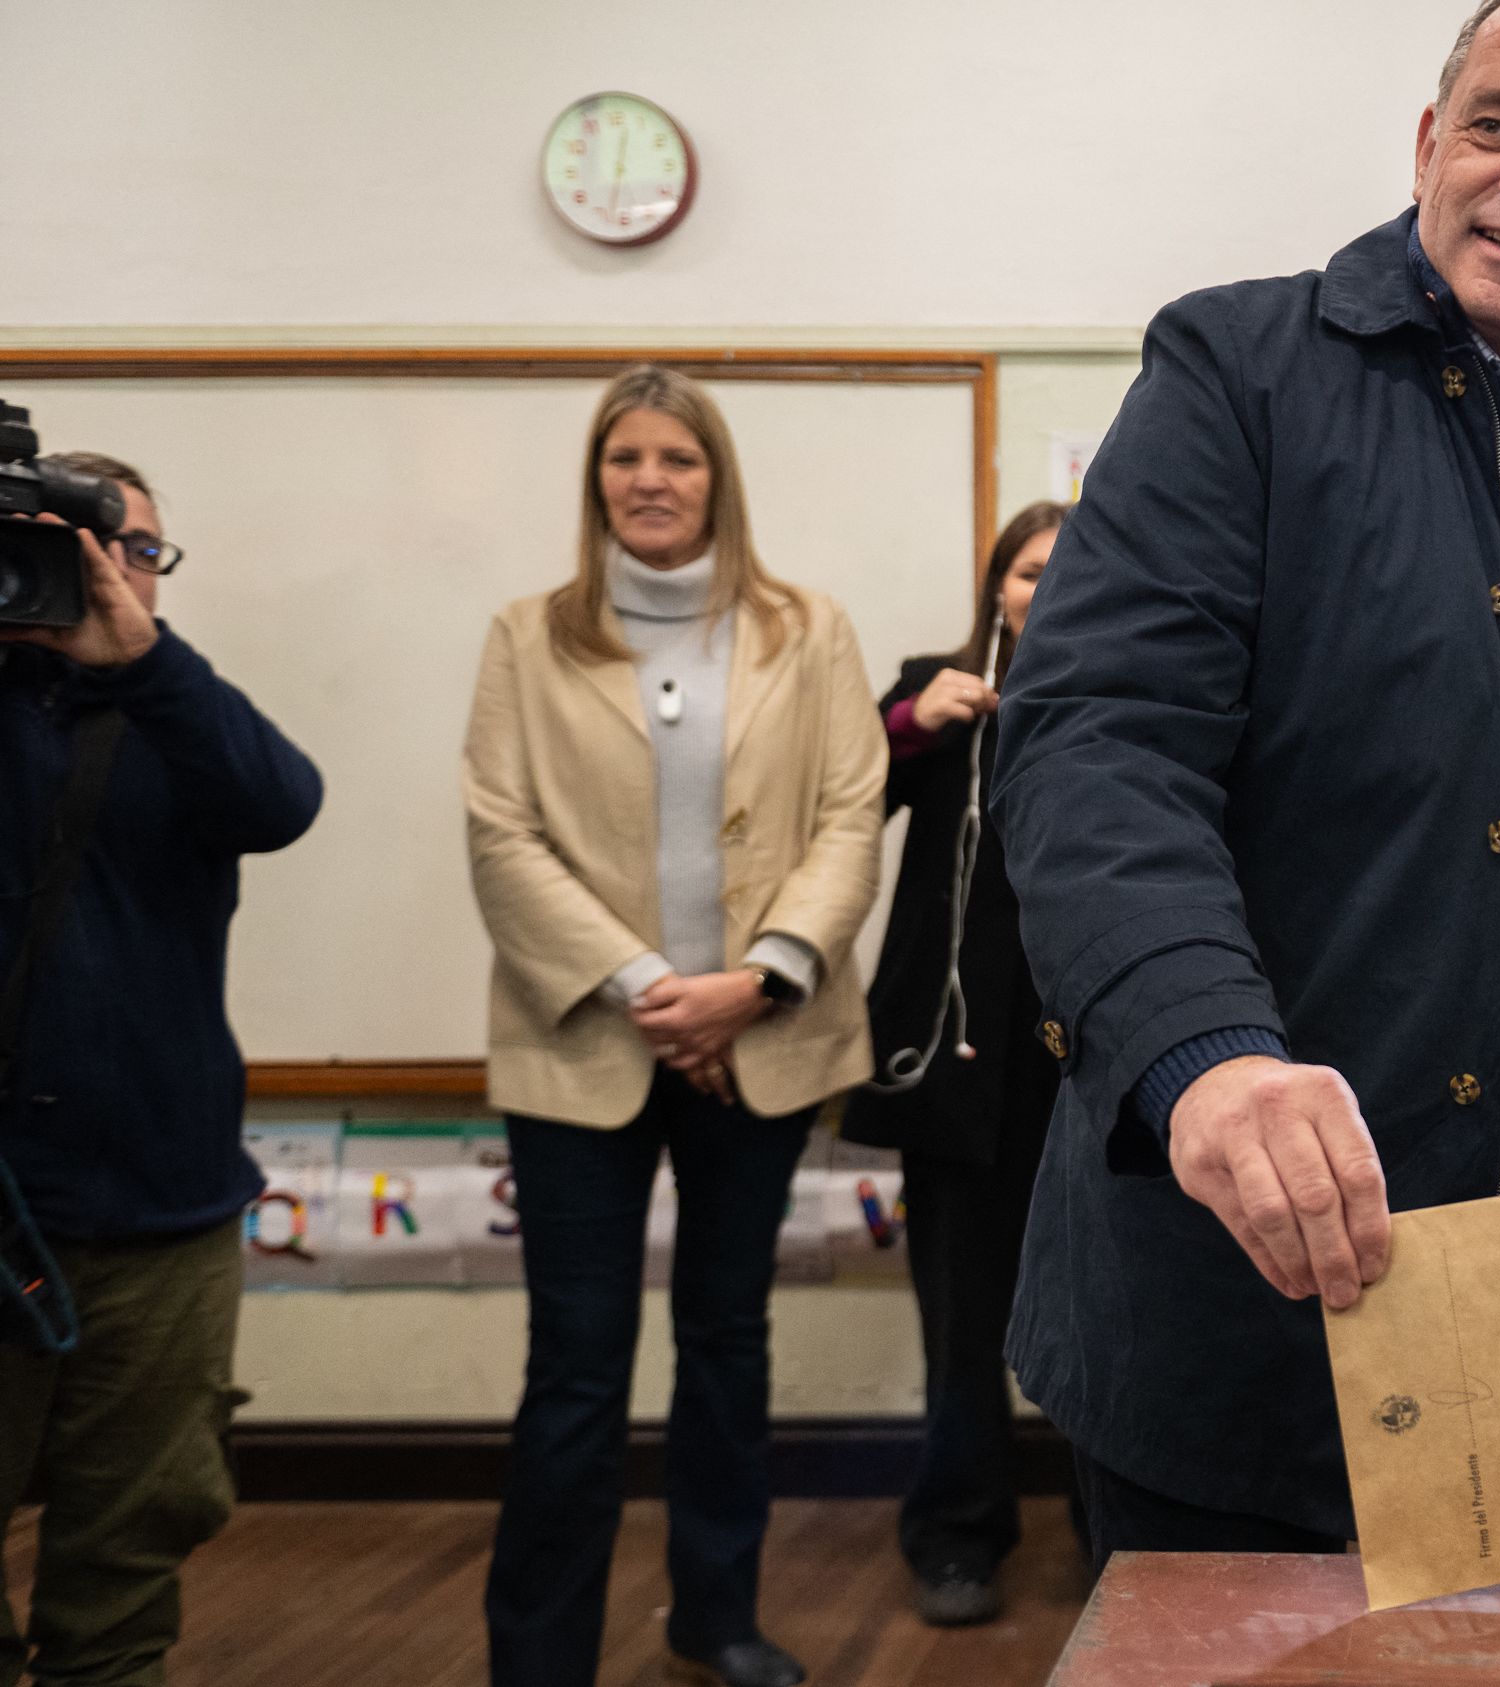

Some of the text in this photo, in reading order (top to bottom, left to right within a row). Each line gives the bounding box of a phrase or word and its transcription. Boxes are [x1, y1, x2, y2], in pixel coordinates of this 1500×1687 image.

[243, 1188, 315, 1263] Q
[371, 1171, 419, 1237] R
[1467, 1453, 1492, 1558] Firma del Presidente
